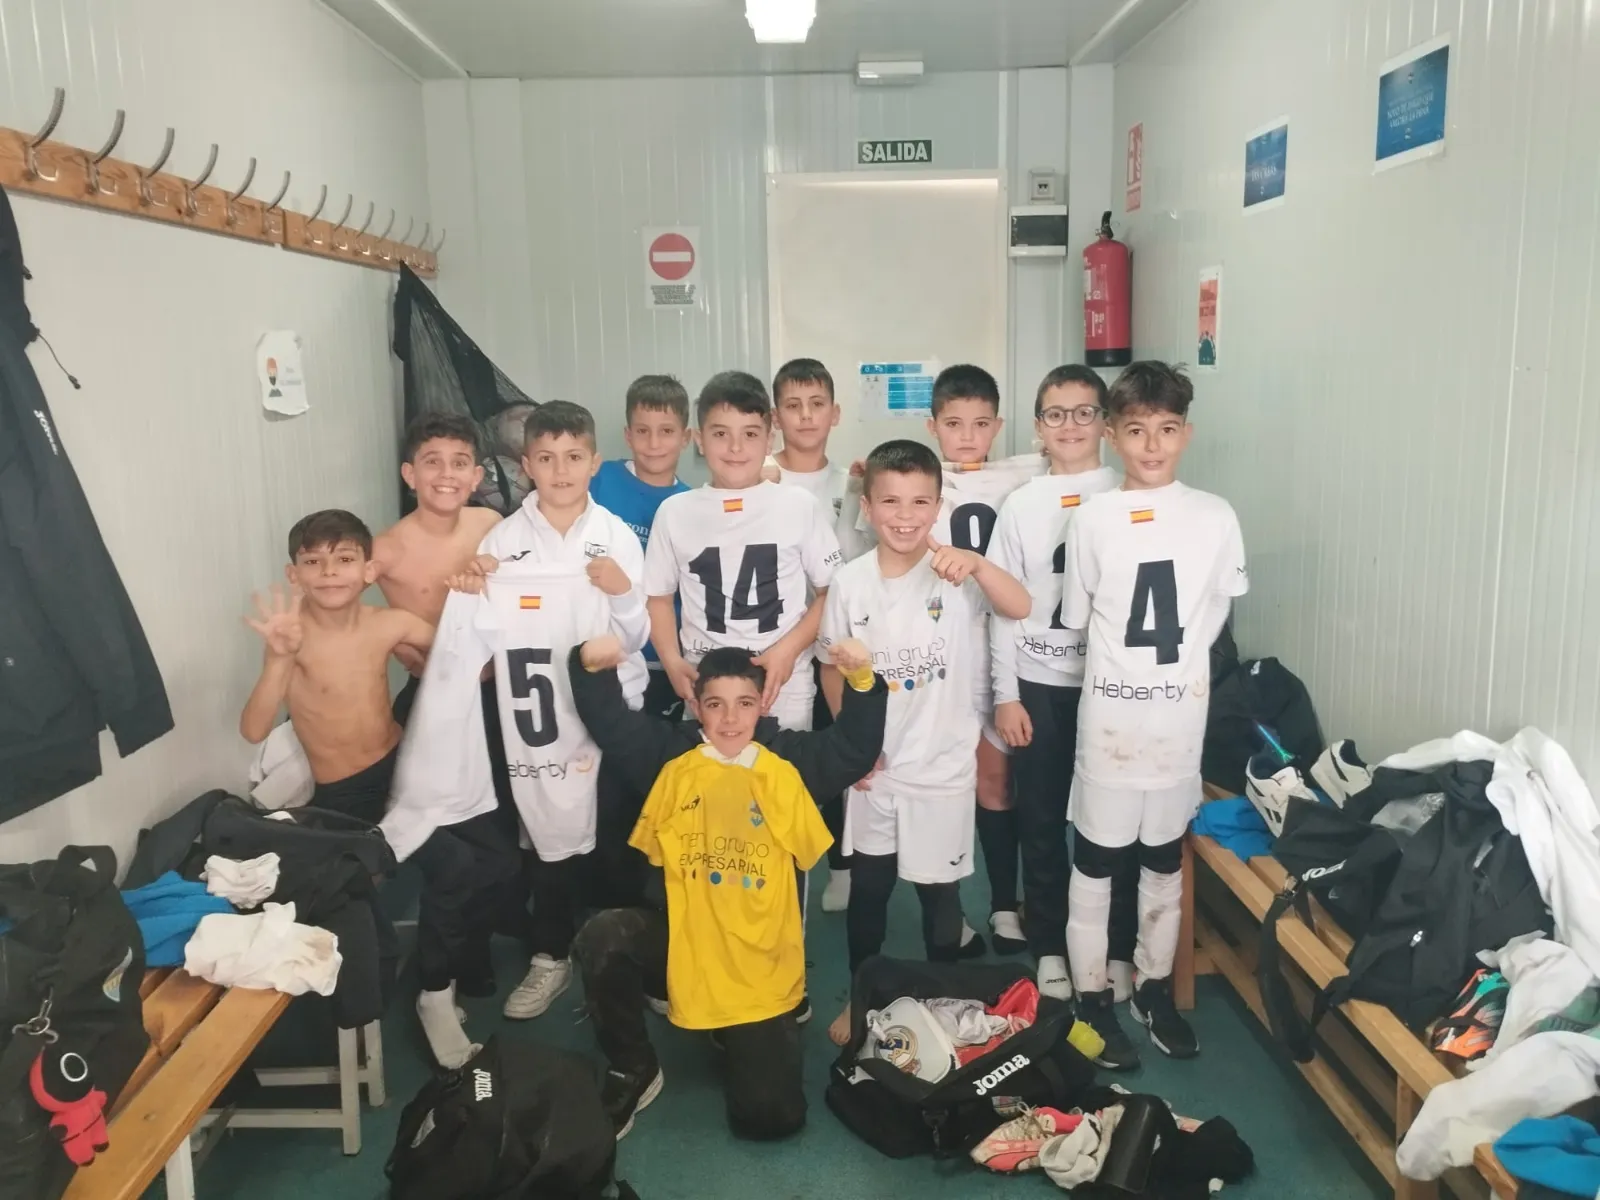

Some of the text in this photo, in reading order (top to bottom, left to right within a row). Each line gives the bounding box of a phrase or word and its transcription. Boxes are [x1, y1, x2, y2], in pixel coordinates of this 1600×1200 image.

[862, 142, 928, 161] SALIDA
[688, 543, 785, 634] 14
[1124, 559, 1185, 666] 4
[1023, 635, 1087, 657] Hebert
[506, 647, 559, 748] 5
[1093, 675, 1188, 703] Heberty
[508, 760, 568, 780] eberty
[713, 835, 770, 862] grupo
